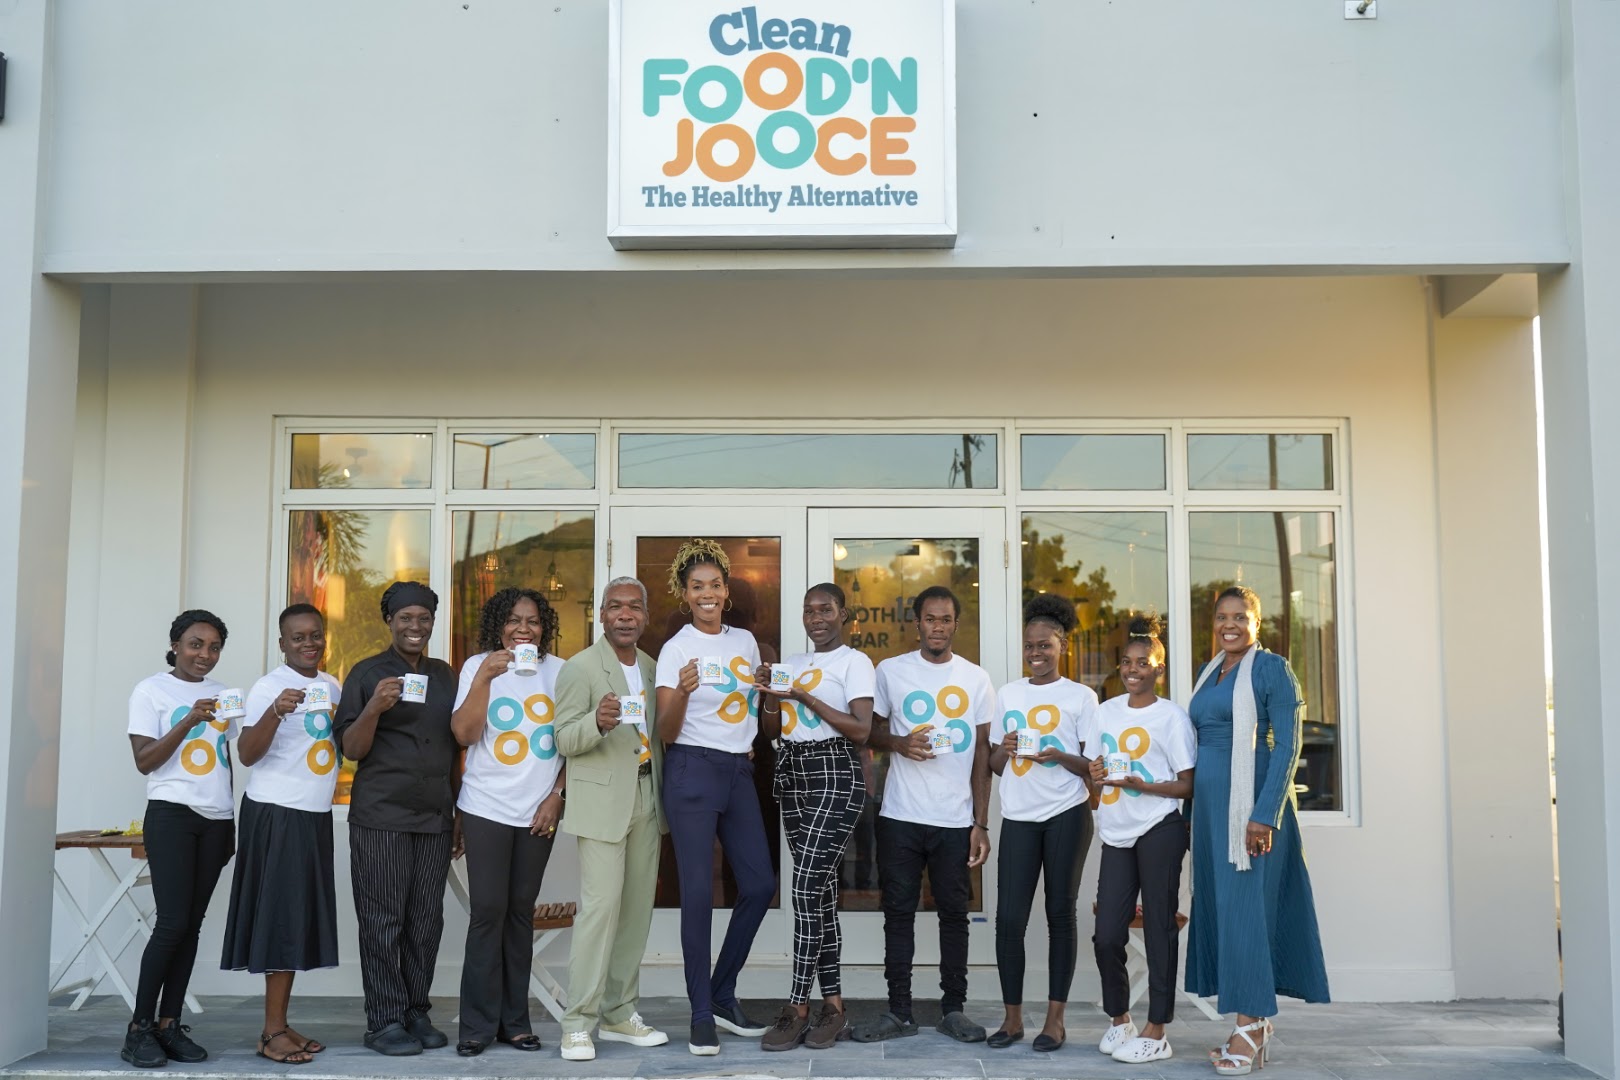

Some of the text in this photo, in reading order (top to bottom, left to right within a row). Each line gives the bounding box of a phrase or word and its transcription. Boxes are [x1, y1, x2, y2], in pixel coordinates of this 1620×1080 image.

[709, 6, 851, 58] Clean
[643, 52, 918, 123] FOOD'N
[662, 110, 917, 182] JOOCE
[642, 184, 918, 213] The Healthy Alternative
[850, 632, 889, 648] BAR
